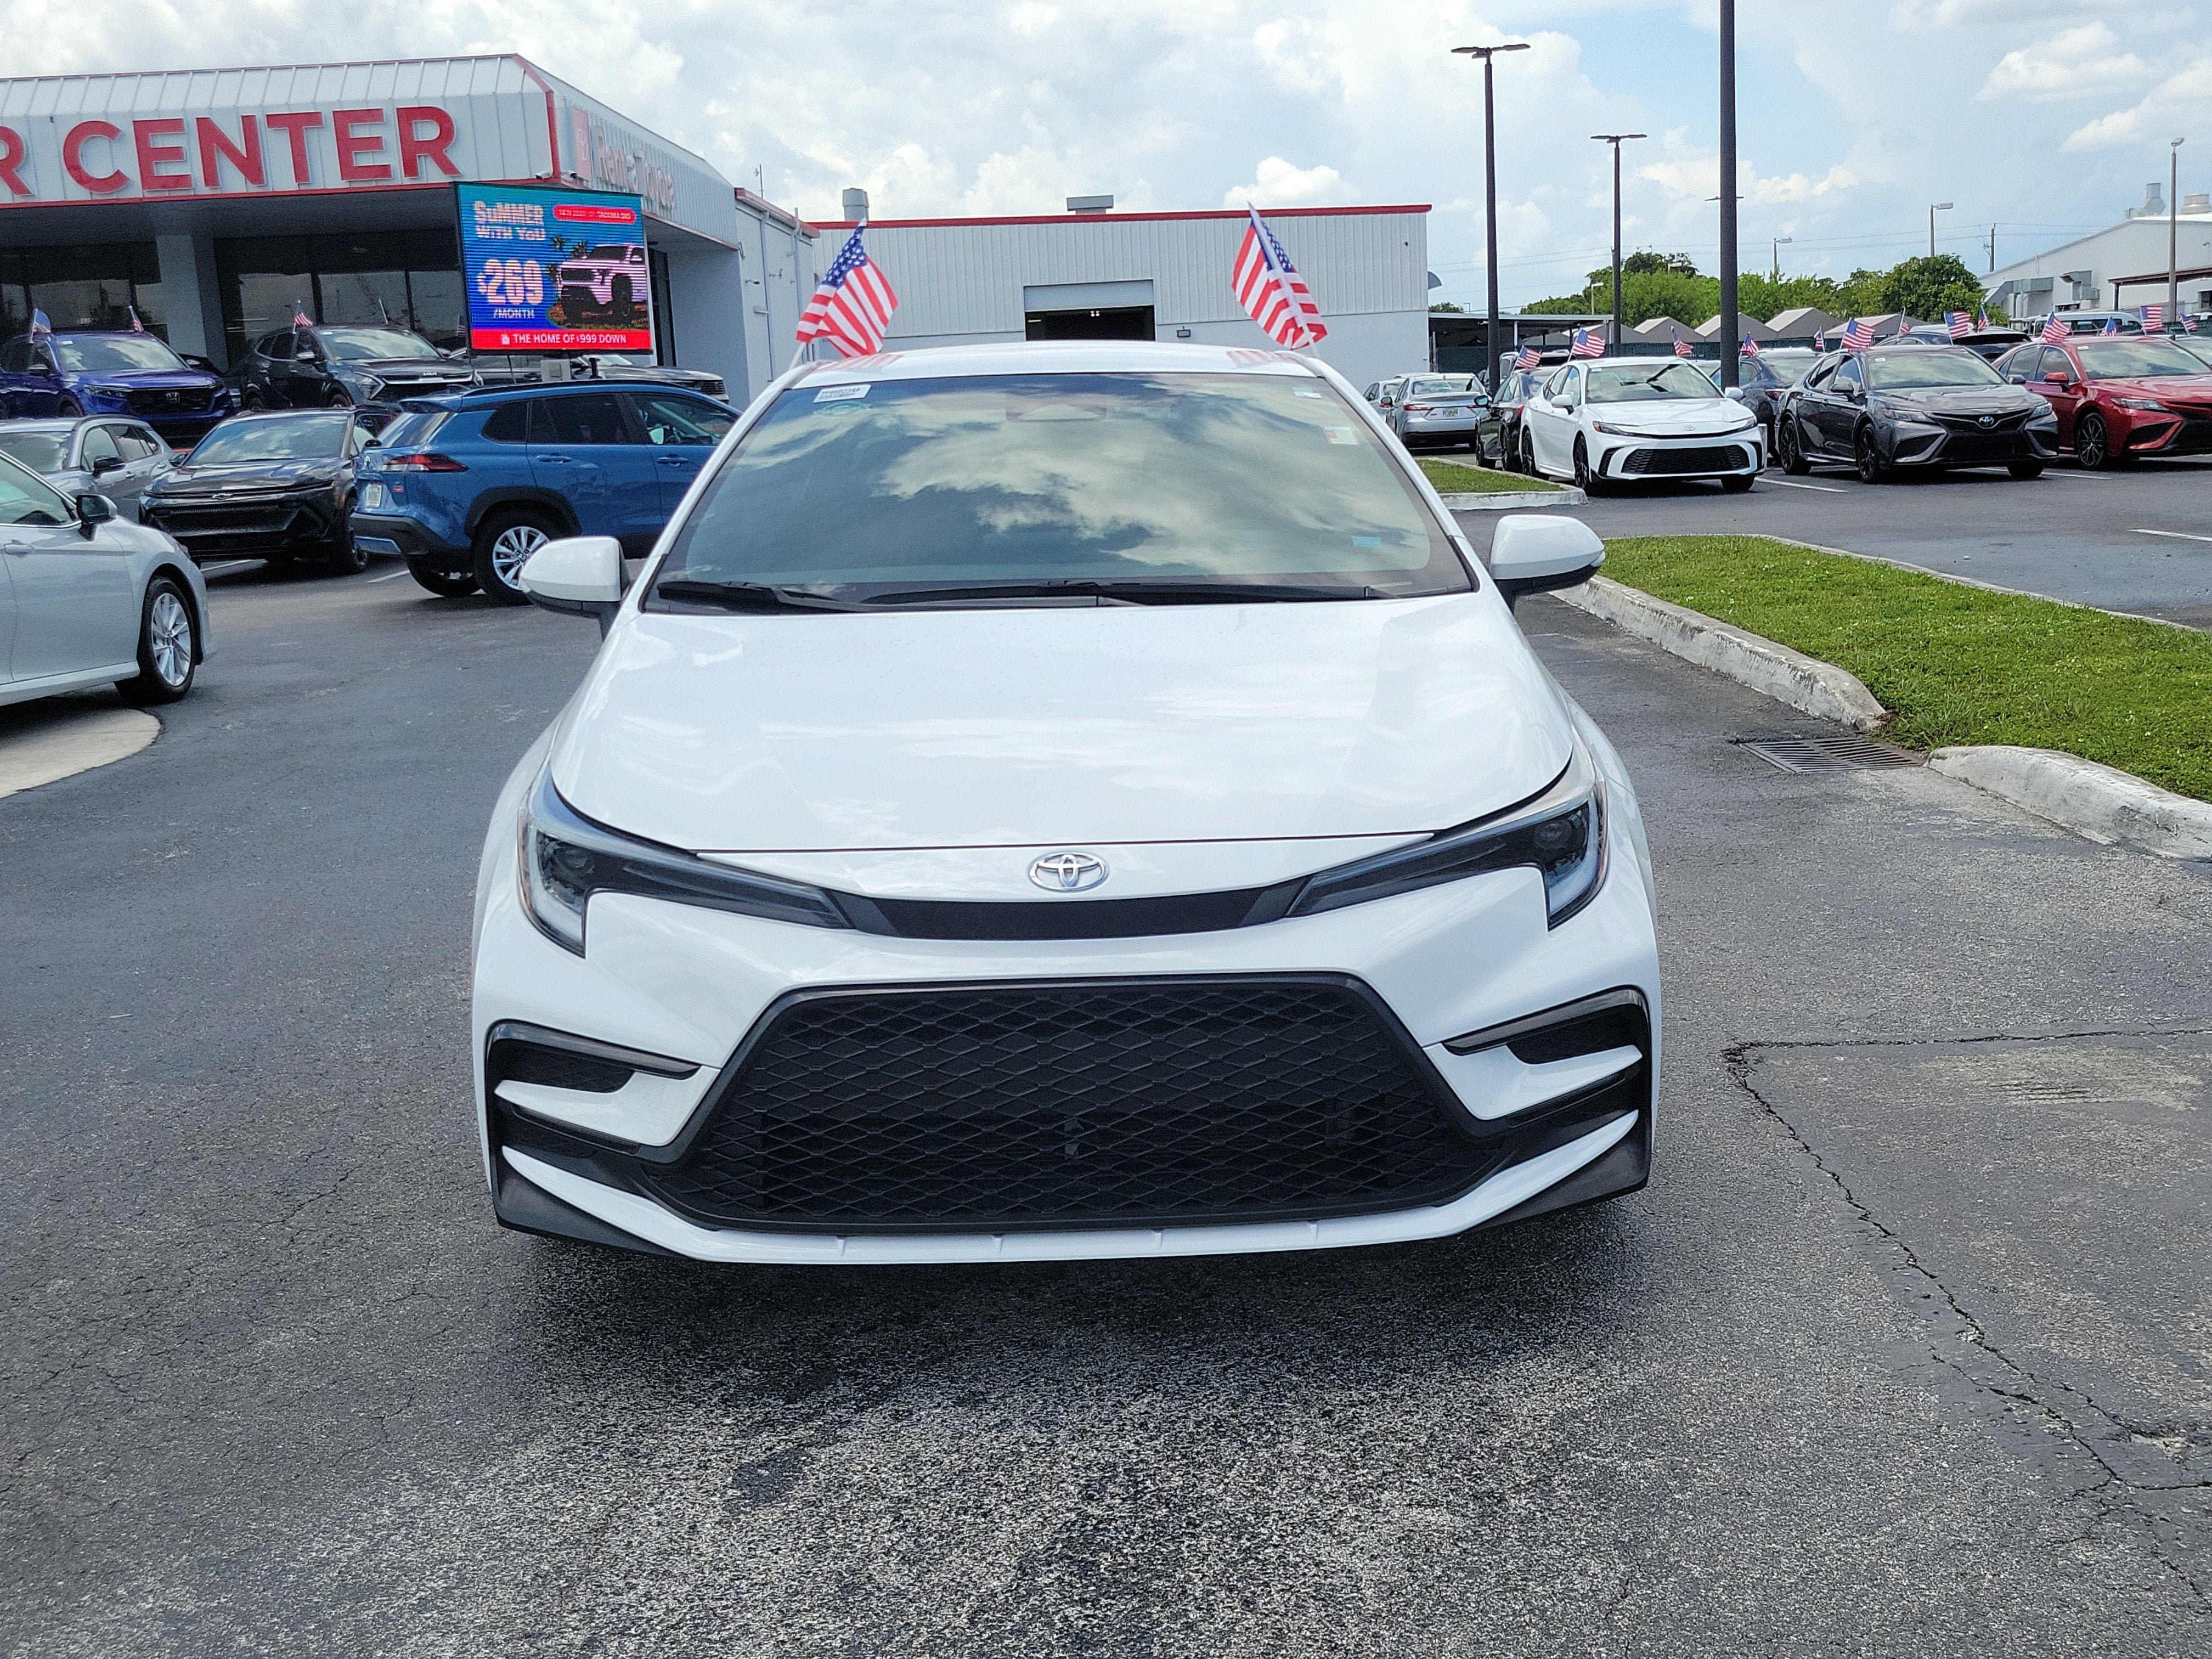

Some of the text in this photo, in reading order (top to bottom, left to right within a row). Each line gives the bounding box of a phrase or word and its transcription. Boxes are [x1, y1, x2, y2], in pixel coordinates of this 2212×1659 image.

[63, 106, 461, 194] CENTER
[476, 258, 543, 306] $269
[512, 333, 627, 343] THE HOME OF $999 DOWN
